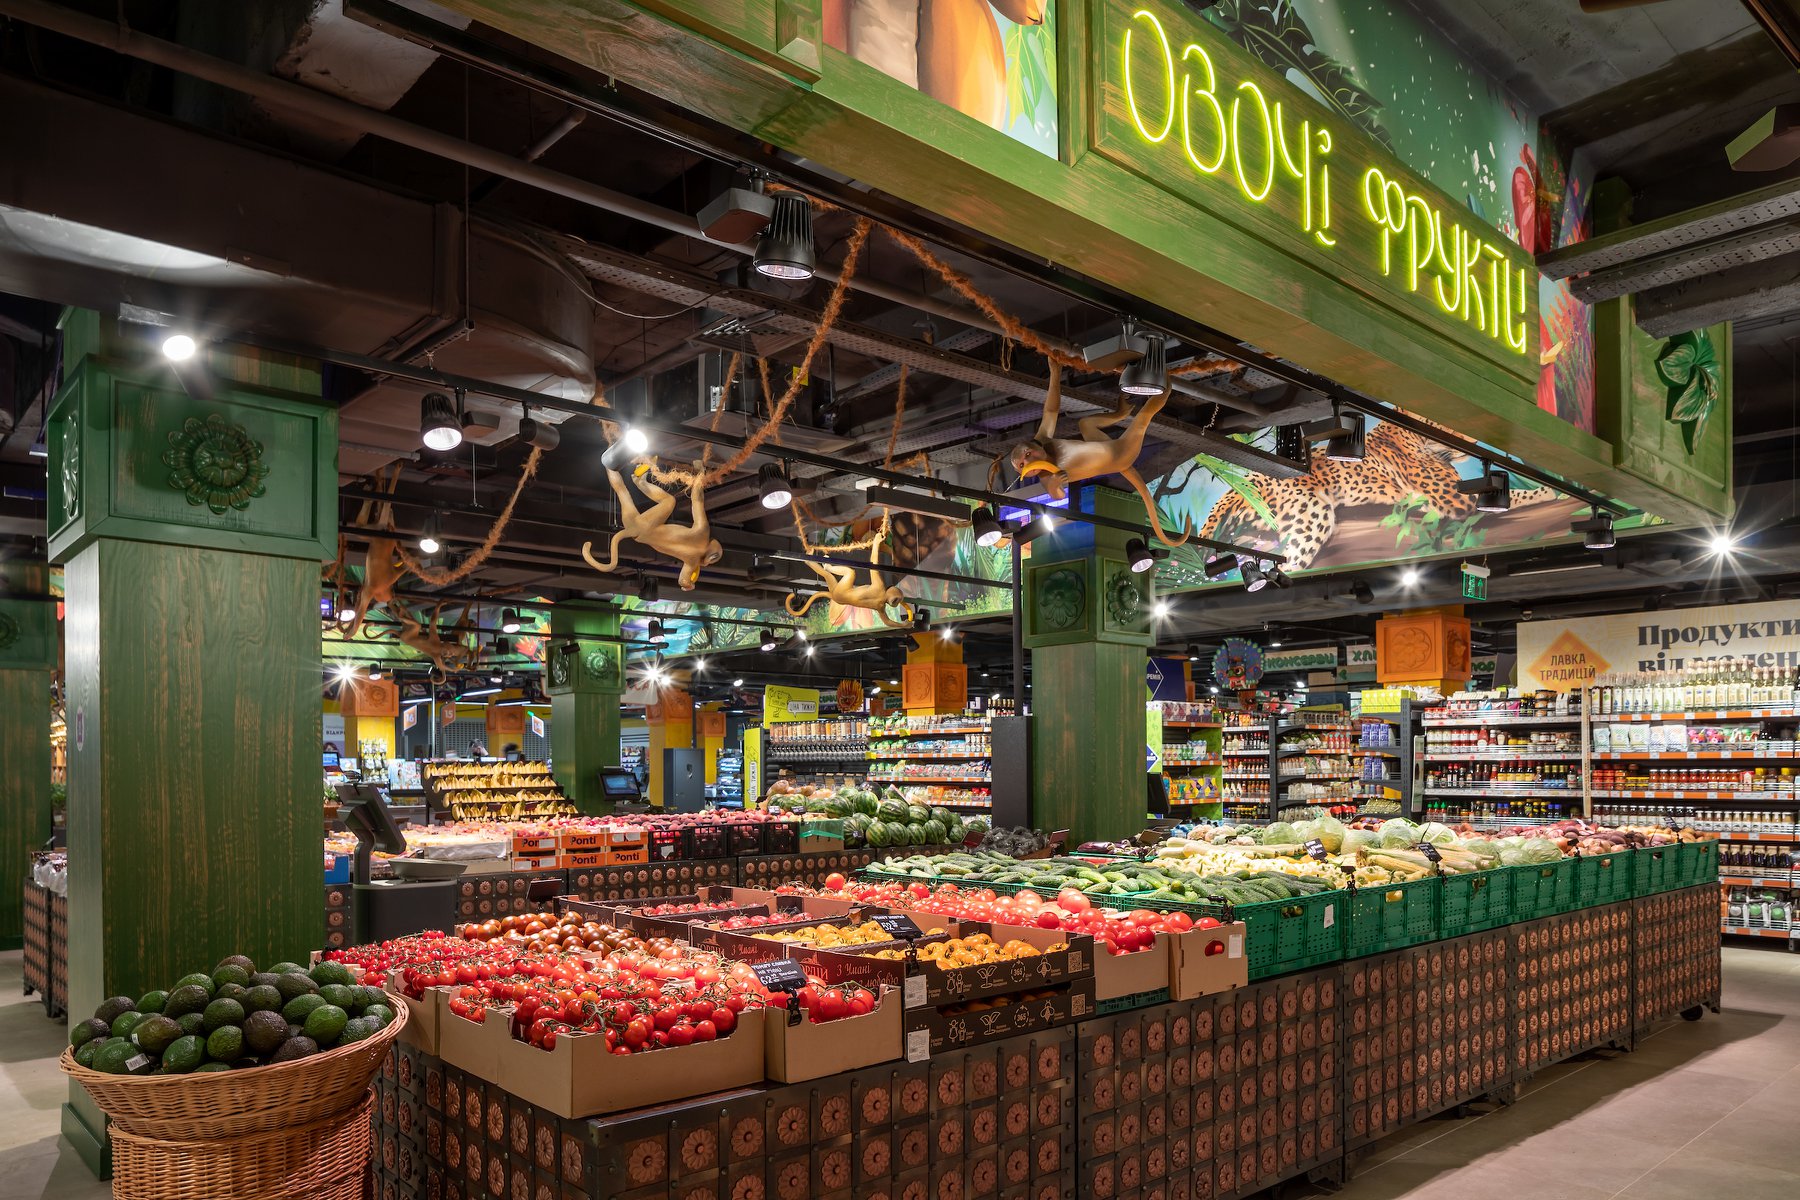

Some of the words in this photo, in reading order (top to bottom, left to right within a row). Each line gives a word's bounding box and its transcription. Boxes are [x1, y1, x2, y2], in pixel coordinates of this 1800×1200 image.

[1363, 167, 1528, 354] ФРУКТИ
[1638, 619, 1800, 650] Продукти
[1550, 653, 1586, 666] ЛАВКА
[1540, 665, 1596, 681] ТРАДИЦІЙ
[405, 713, 414, 723] 16
[444, 709, 453, 719] 15
[522, 838, 539, 848] Pon
[571, 836, 597, 845] Ponti
[572, 855, 598, 865] Ponti
[615, 852, 640, 862] Ponti
[1013, 968, 1023, 976] 365
[760, 975, 774, 986] 62
[1017, 1013, 1027, 1021] 365
